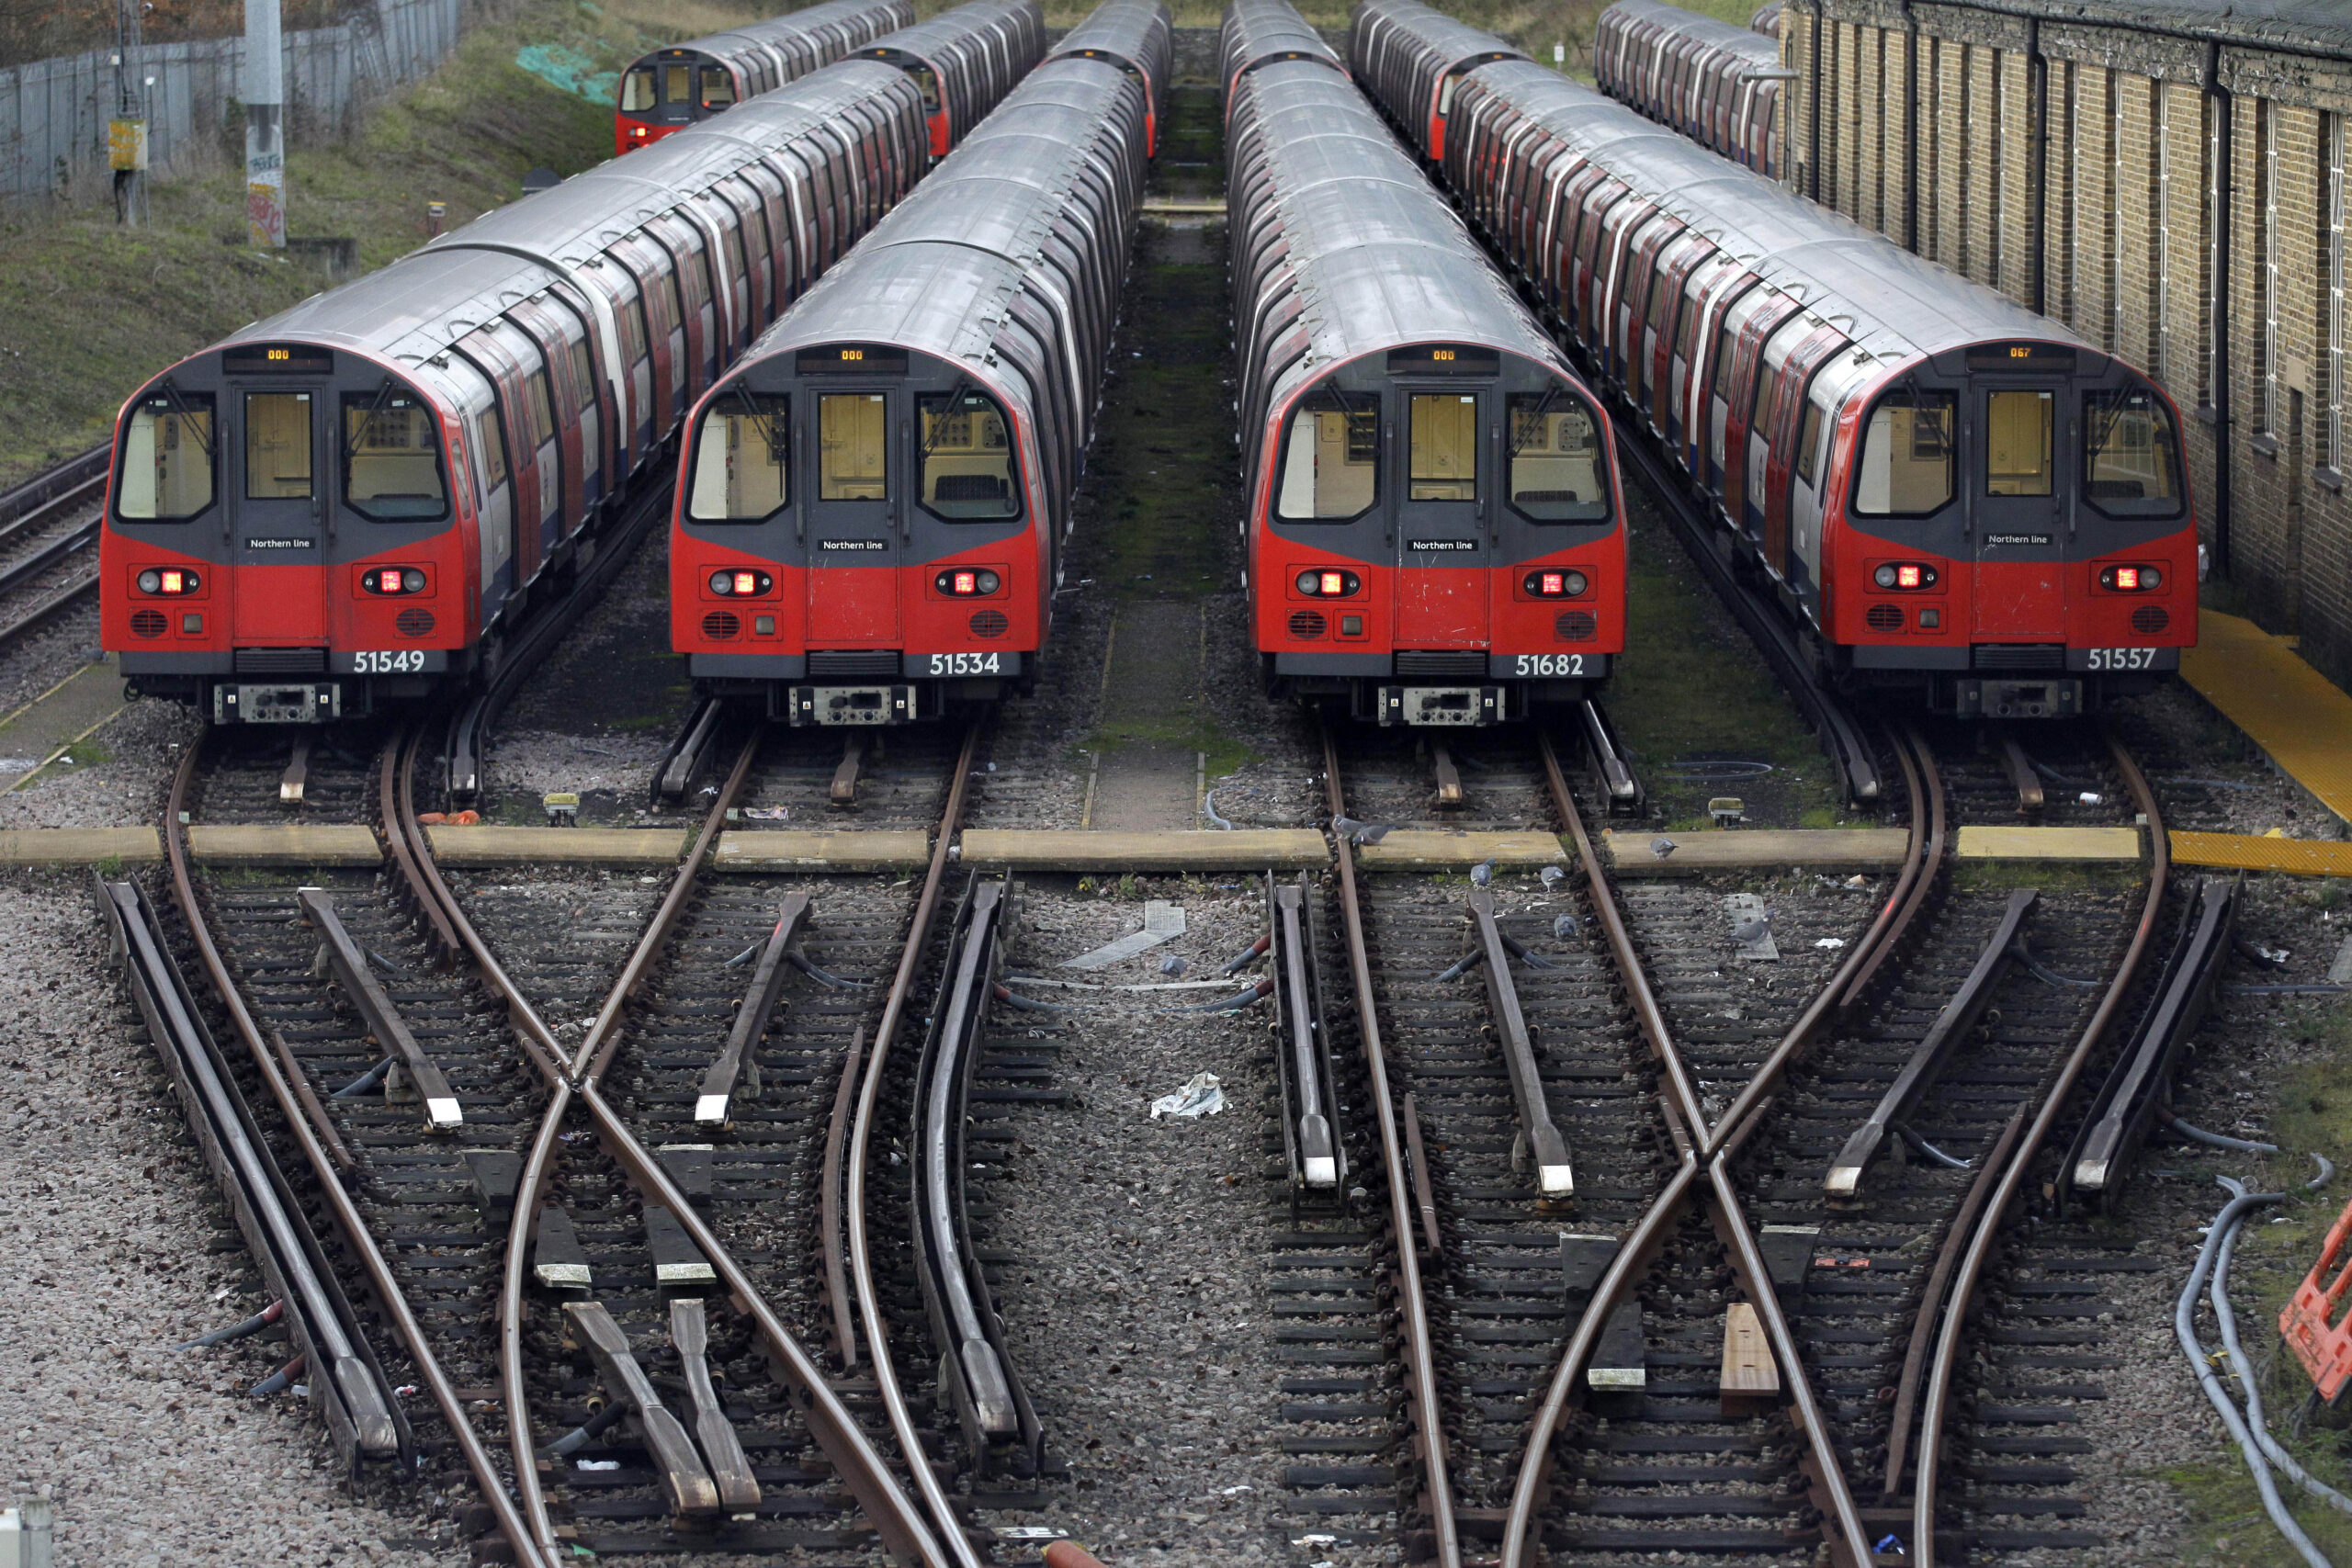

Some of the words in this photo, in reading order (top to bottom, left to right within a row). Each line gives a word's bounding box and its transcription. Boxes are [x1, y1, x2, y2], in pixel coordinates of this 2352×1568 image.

[842, 350, 863, 360] 000
[1433, 350, 1454, 361] 000
[2010, 347, 2030, 357] 067
[250, 539, 291, 548] Northern
[292, 539, 310, 548] line
[1988, 535, 2030, 544] Northern
[2030, 535, 2048, 544] line
[823, 540, 865, 550] Northern
[866, 540, 883, 550] line
[1413, 540, 1454, 550] Northern
[1456, 540, 1473, 550] line
[354, 649, 424, 673] 51549
[929, 652, 1001, 675] 51534
[2086, 648, 2156, 670] 51557
[1515, 653, 1583, 676] 51682
